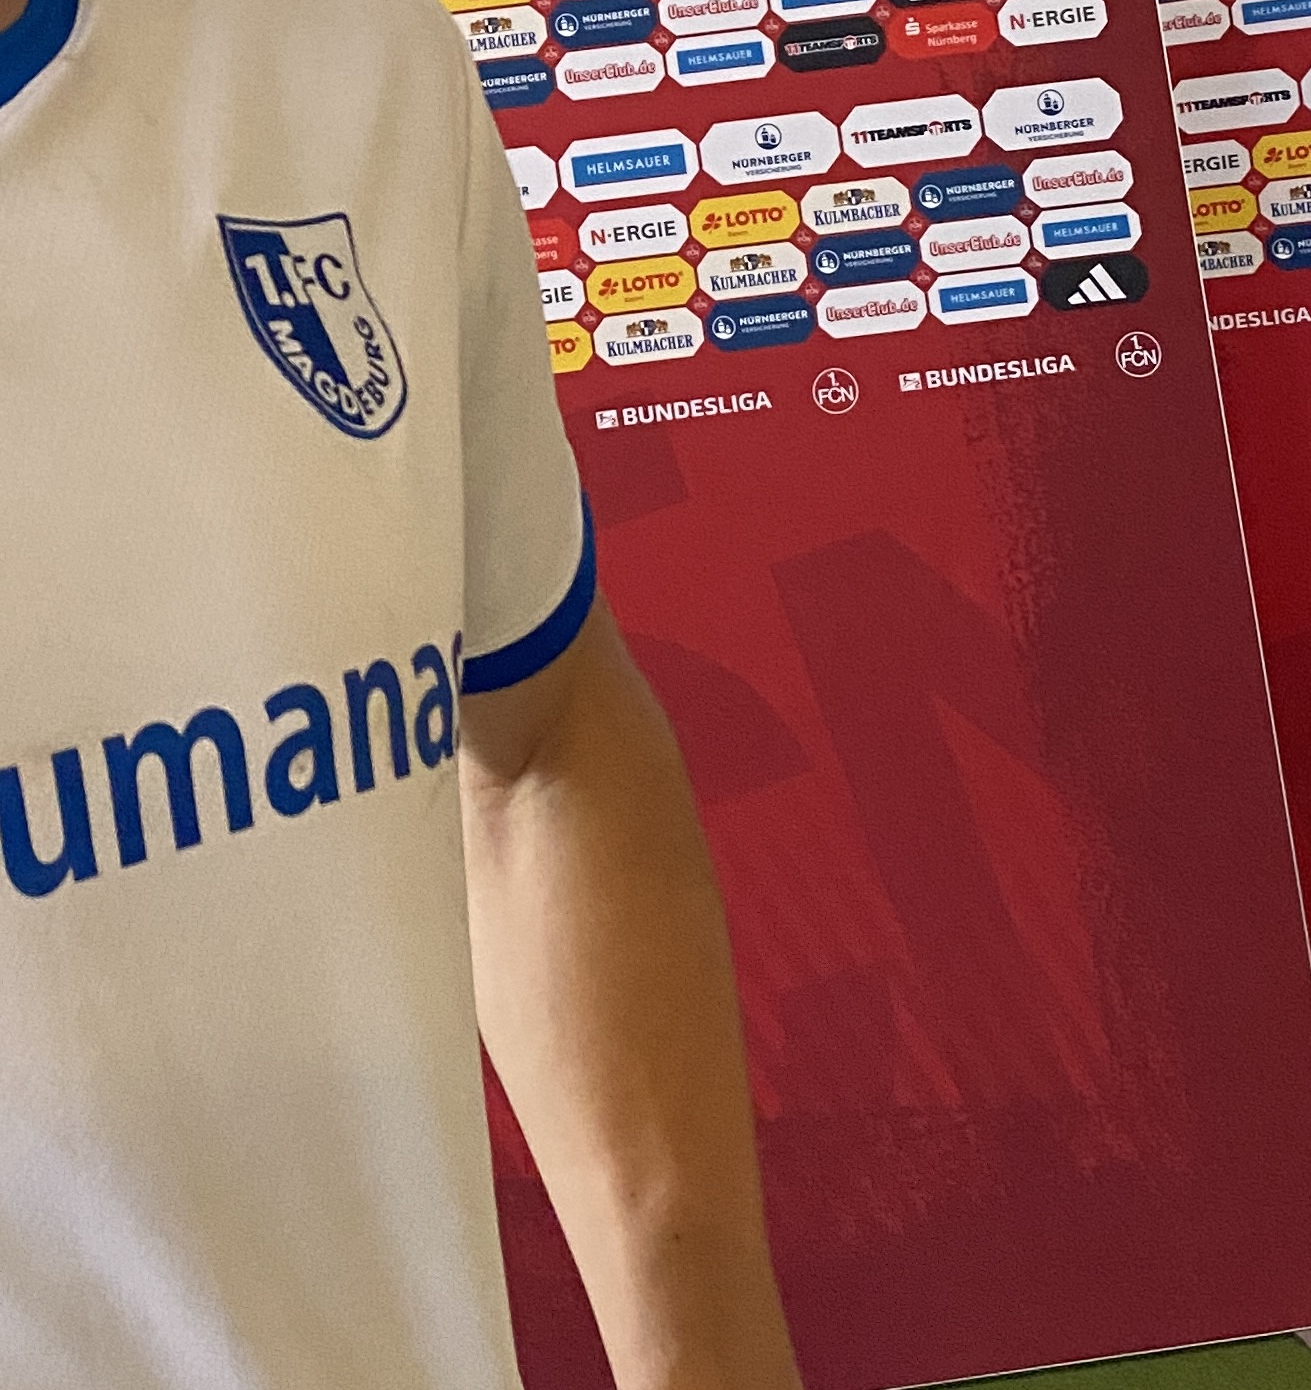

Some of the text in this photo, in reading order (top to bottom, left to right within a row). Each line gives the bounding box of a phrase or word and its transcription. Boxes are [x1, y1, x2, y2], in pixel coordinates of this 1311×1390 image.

[925, 19, 979, 35] Sparkasse
[1163, 12, 1222, 32] erClub.de
[467, 31, 538, 52] LMBACHER
[927, 32, 978, 48] Nürnberg
[688, 49, 753, 66] HELMSAUER
[565, 60, 656, 84] UnserClub.de
[1015, 117, 1095, 136] NÜRNBERGER
[586, 154, 671, 176] HELMSAUER
[732, 151, 812, 170] NÜRNBERGER
[1184, 154, 1240, 174] ERGIE
[1033, 168, 1124, 192] UnserClub.de
[726, 207, 784, 228] LOTTO
[814, 202, 901, 226] KULMBACHER
[1053, 222, 1118, 239] HELMSAUER
[929, 233, 1021, 257] UnserClub.de
[622, 273, 681, 294] LOTTO
[710, 267, 798, 292] KULMBACHER
[950, 287, 1016, 304] HELMSAUER
[826, 298, 918, 322] UnserClub.de
[1209, 307, 1311, 331] NDESLIGA
[606, 333, 694, 358] KULMBACHER
[268, 316, 391, 416] MAGDEBURG
[1120, 349, 1157, 368] FCN
[925, 355, 1076, 389] BUNDESLIGA
[818, 385, 854, 405] FCN
[621, 391, 773, 426] BUNDESLIGA
